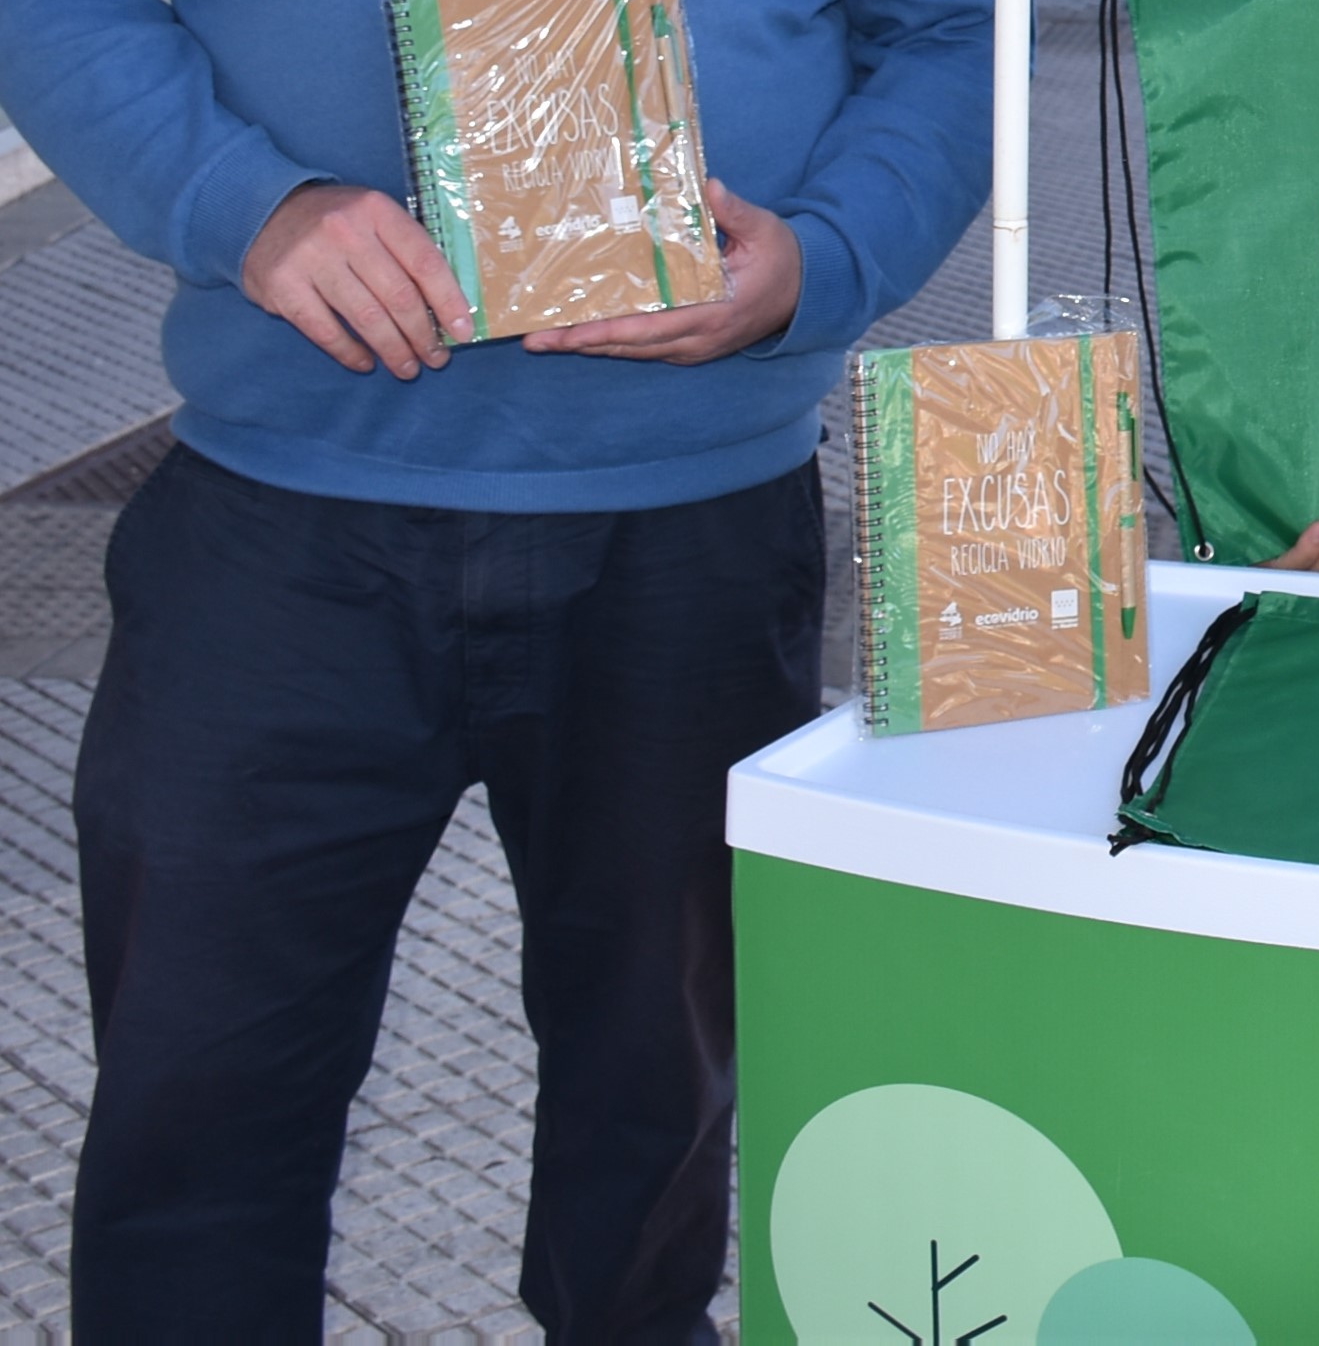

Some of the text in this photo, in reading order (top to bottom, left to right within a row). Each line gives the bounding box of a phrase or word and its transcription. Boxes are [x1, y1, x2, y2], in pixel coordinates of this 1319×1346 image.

[486, 82, 619, 154] EXCUSAS
[976, 429, 1037, 464] NO HAY
[943, 469, 1071, 535] EXCUSAS
[951, 535, 1066, 576] RECICLA VIDRIO
[975, 606, 1039, 626] ecovidrio
